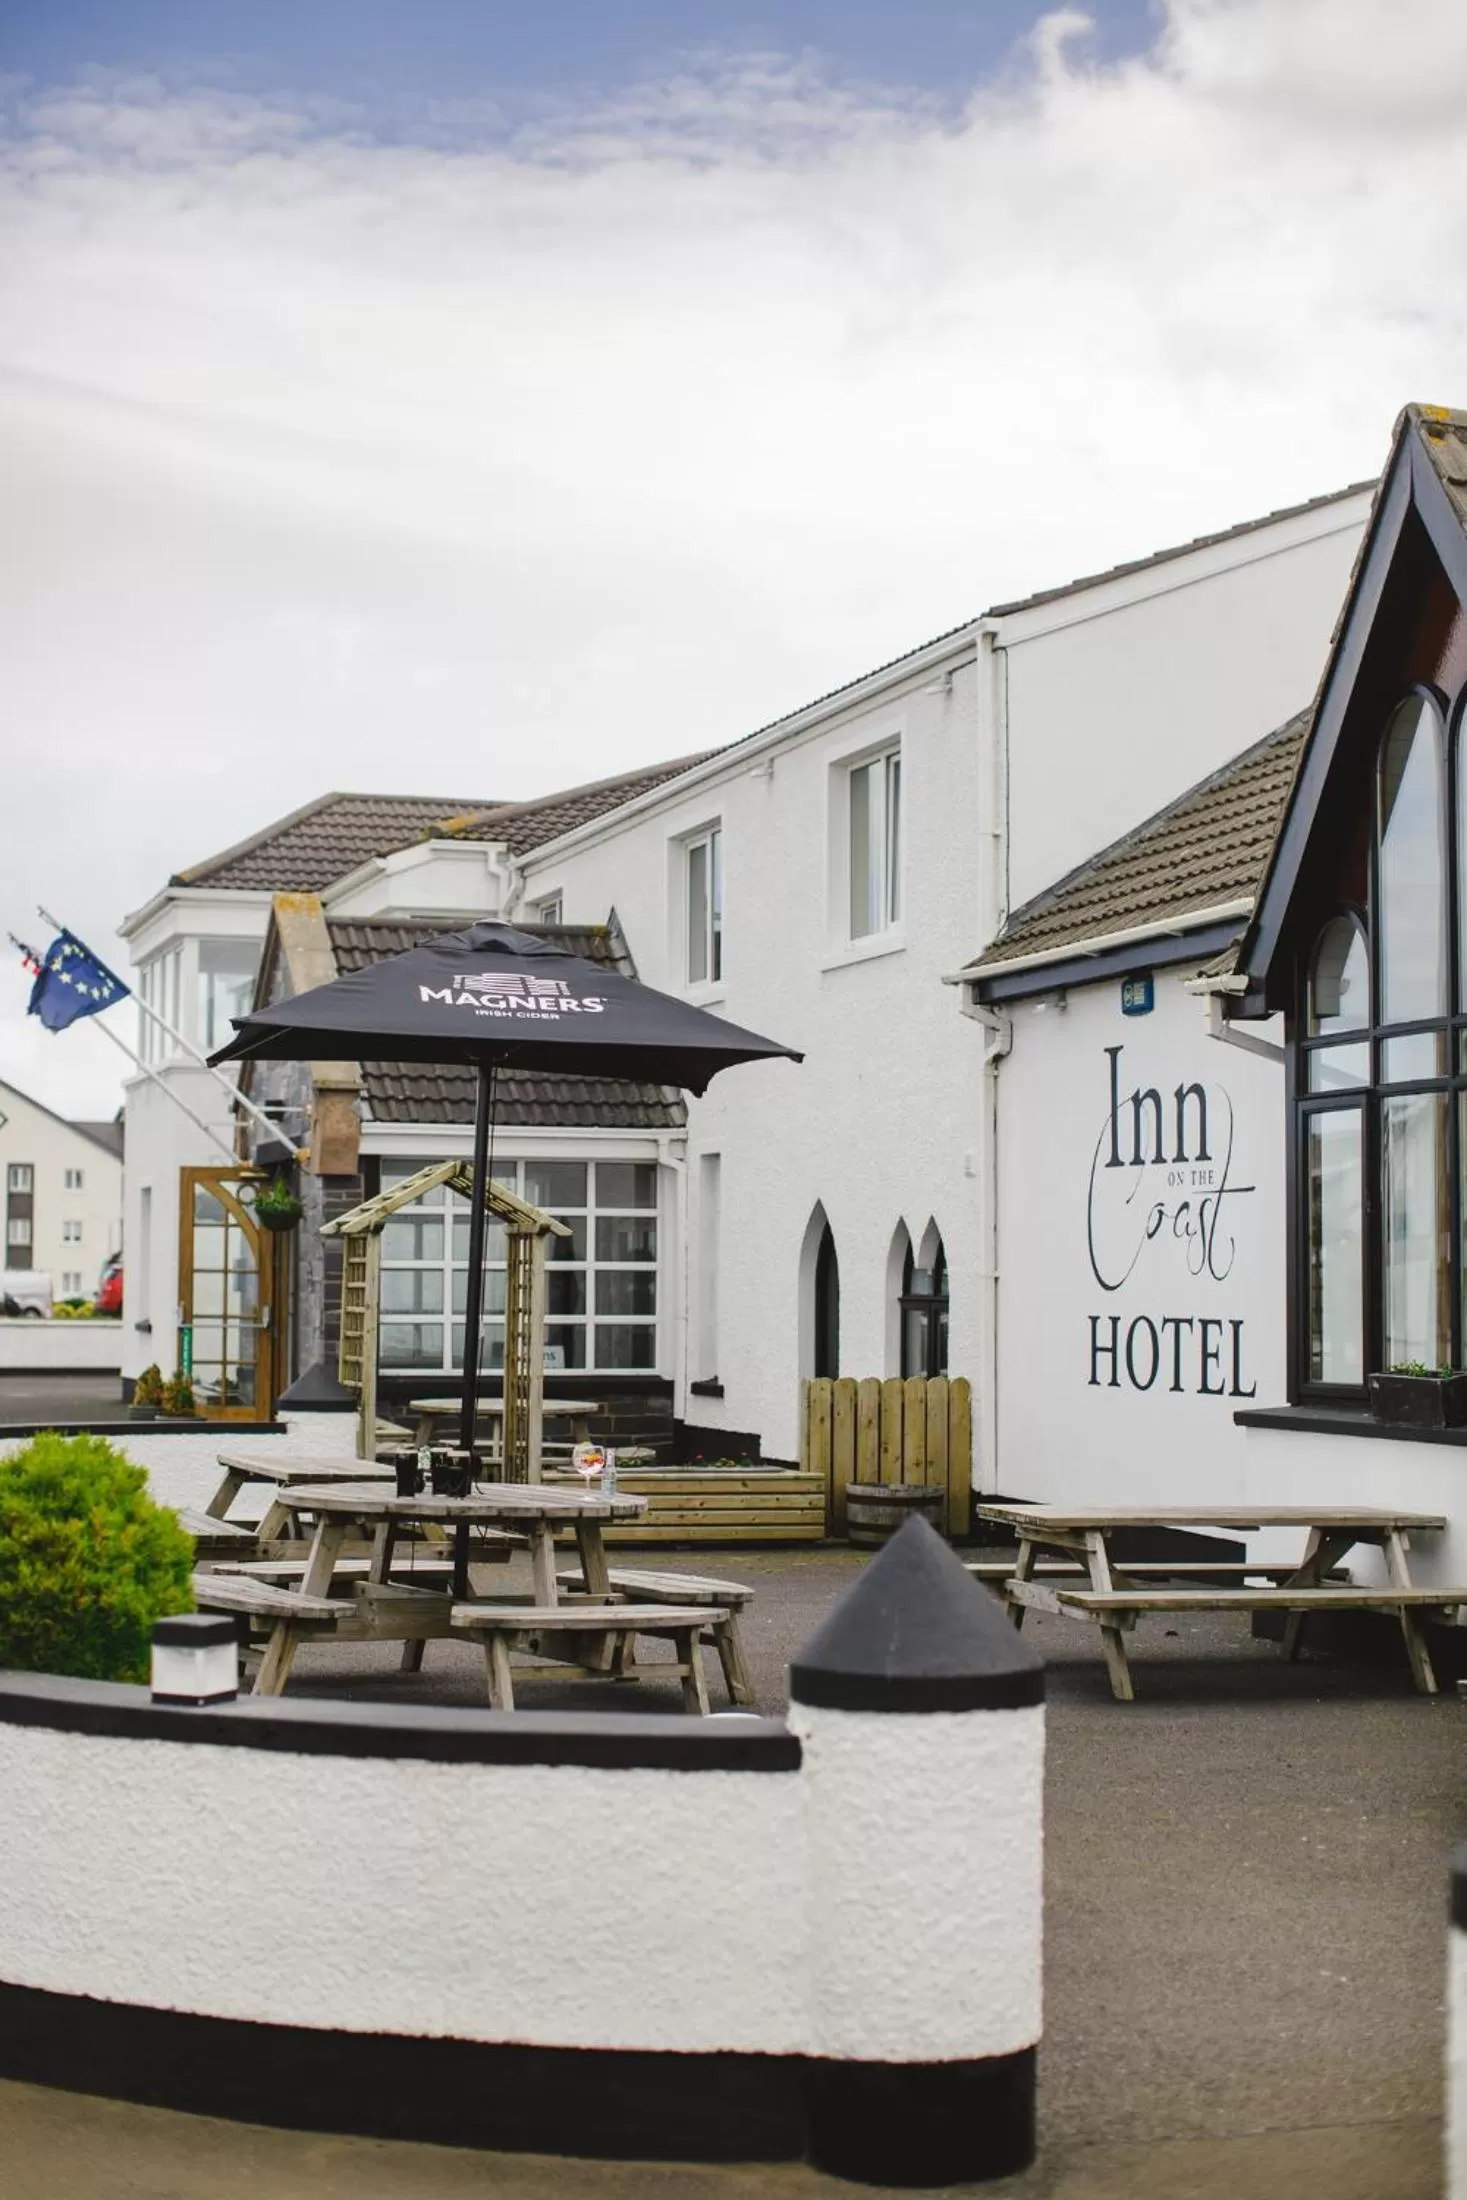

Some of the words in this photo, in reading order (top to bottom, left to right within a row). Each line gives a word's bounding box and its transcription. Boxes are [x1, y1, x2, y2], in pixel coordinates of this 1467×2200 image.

[418, 985, 605, 1013] MAGNERS
[475, 1009, 513, 1017] IRISH
[516, 1011, 560, 1020] CIDER
[1104, 1044, 1212, 1168] Inn
[1087, 1083, 1256, 1291] Coast
[1167, 1171, 1185, 1187] ON
[1191, 1169, 1215, 1186] THE
[1087, 1315, 1257, 1399] HOTEL
